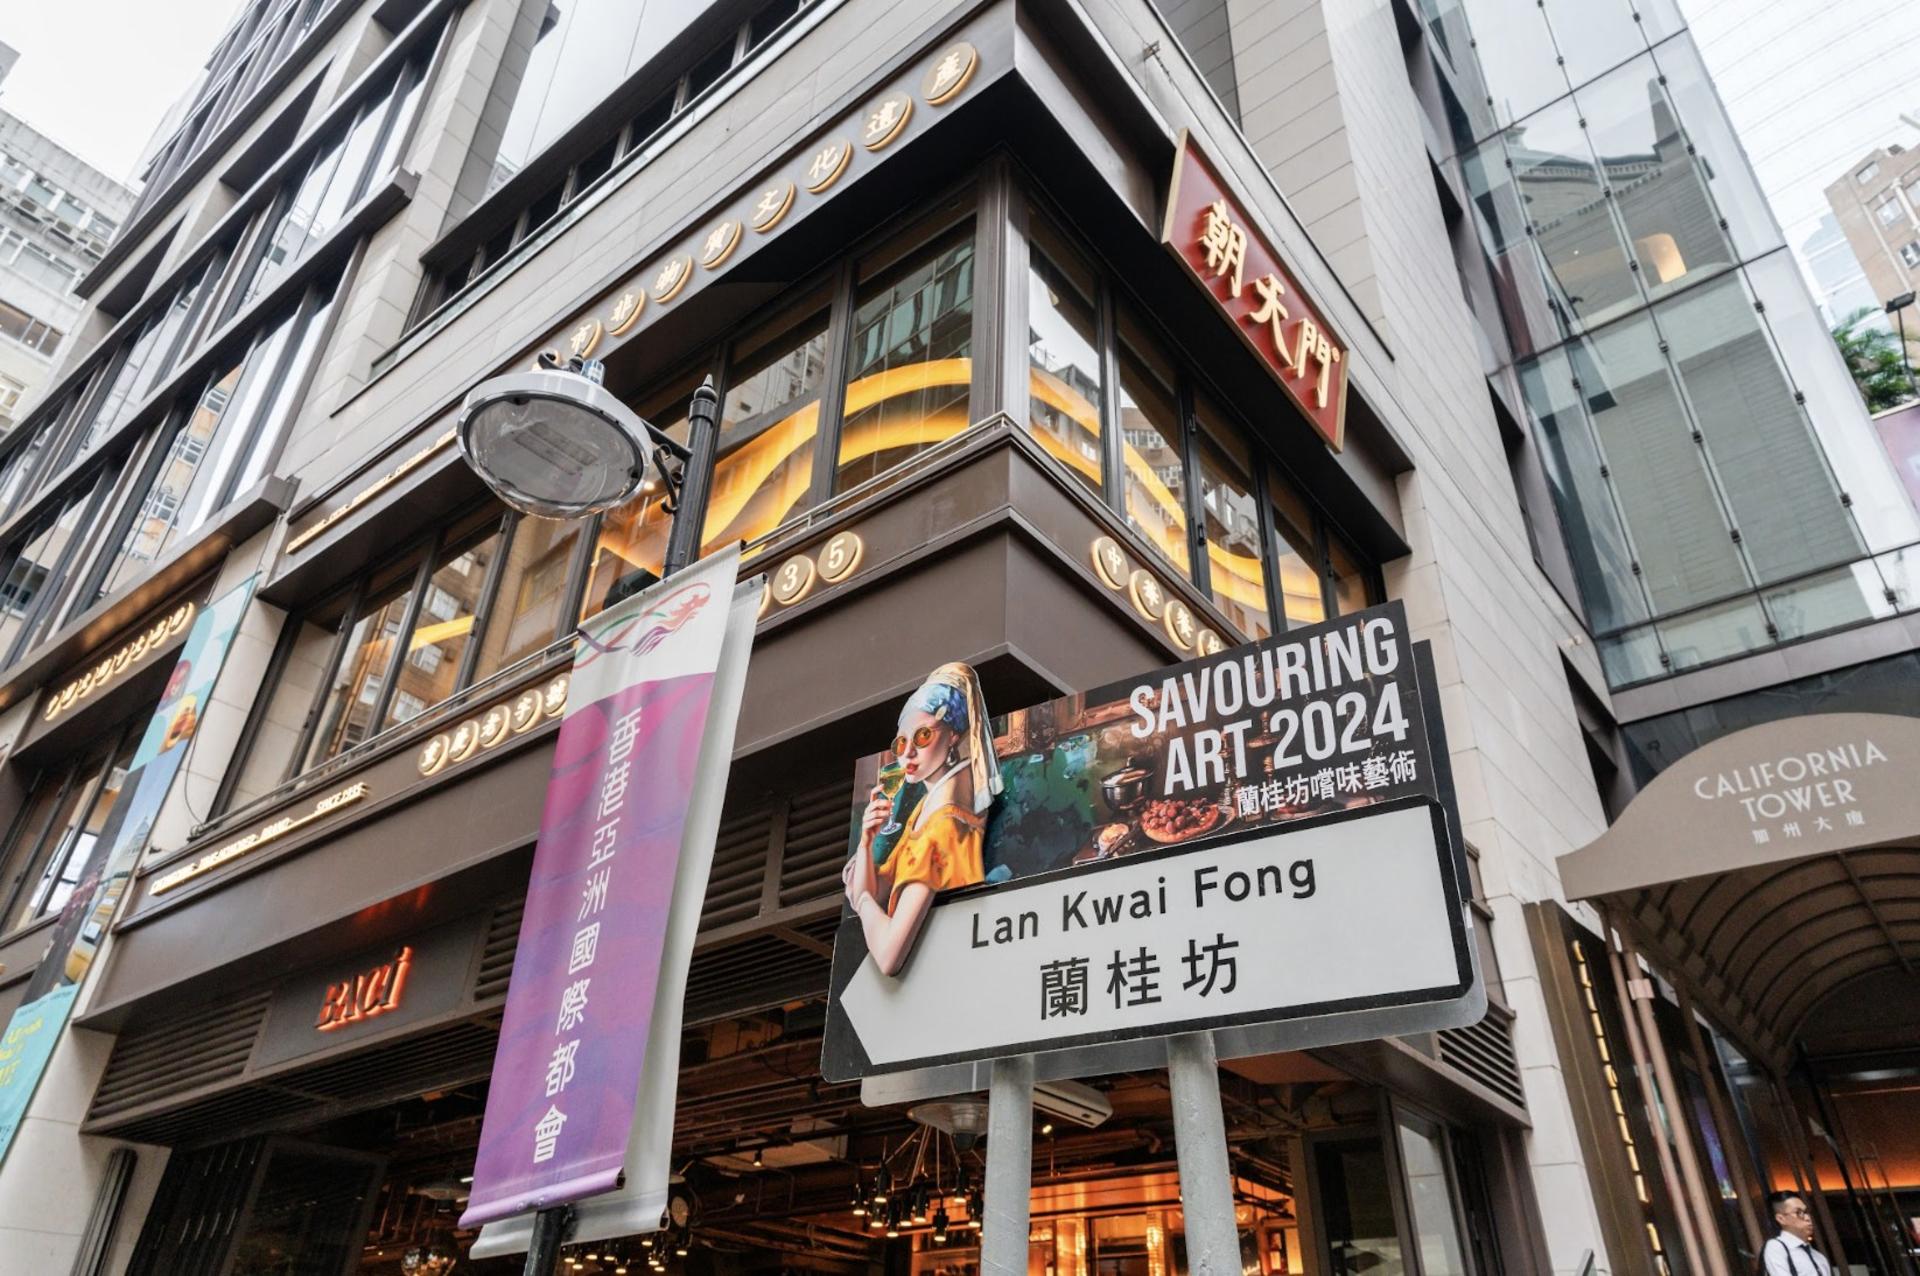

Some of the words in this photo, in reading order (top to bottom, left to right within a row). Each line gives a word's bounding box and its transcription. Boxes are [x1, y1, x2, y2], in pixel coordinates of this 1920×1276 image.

[1199, 199, 1333, 409] 朝天門
[1129, 617, 1400, 740] SAVOURING
[1164, 719, 1253, 796] ART
[1270, 681, 1410, 770] 2024
[1236, 749, 1418, 818] 蘭桂坊嚐味藝術
[1694, 739, 1888, 799] CALIFORNIA
[1739, 778, 1857, 823] TOWER
[533, 706, 642, 1164] 香港亞洲國際都會
[971, 911, 1040, 949] Lan
[1062, 876, 1167, 932] Kwai
[1194, 858, 1317, 909] Fong
[1039, 933, 1240, 1020] 蘭桂坊
